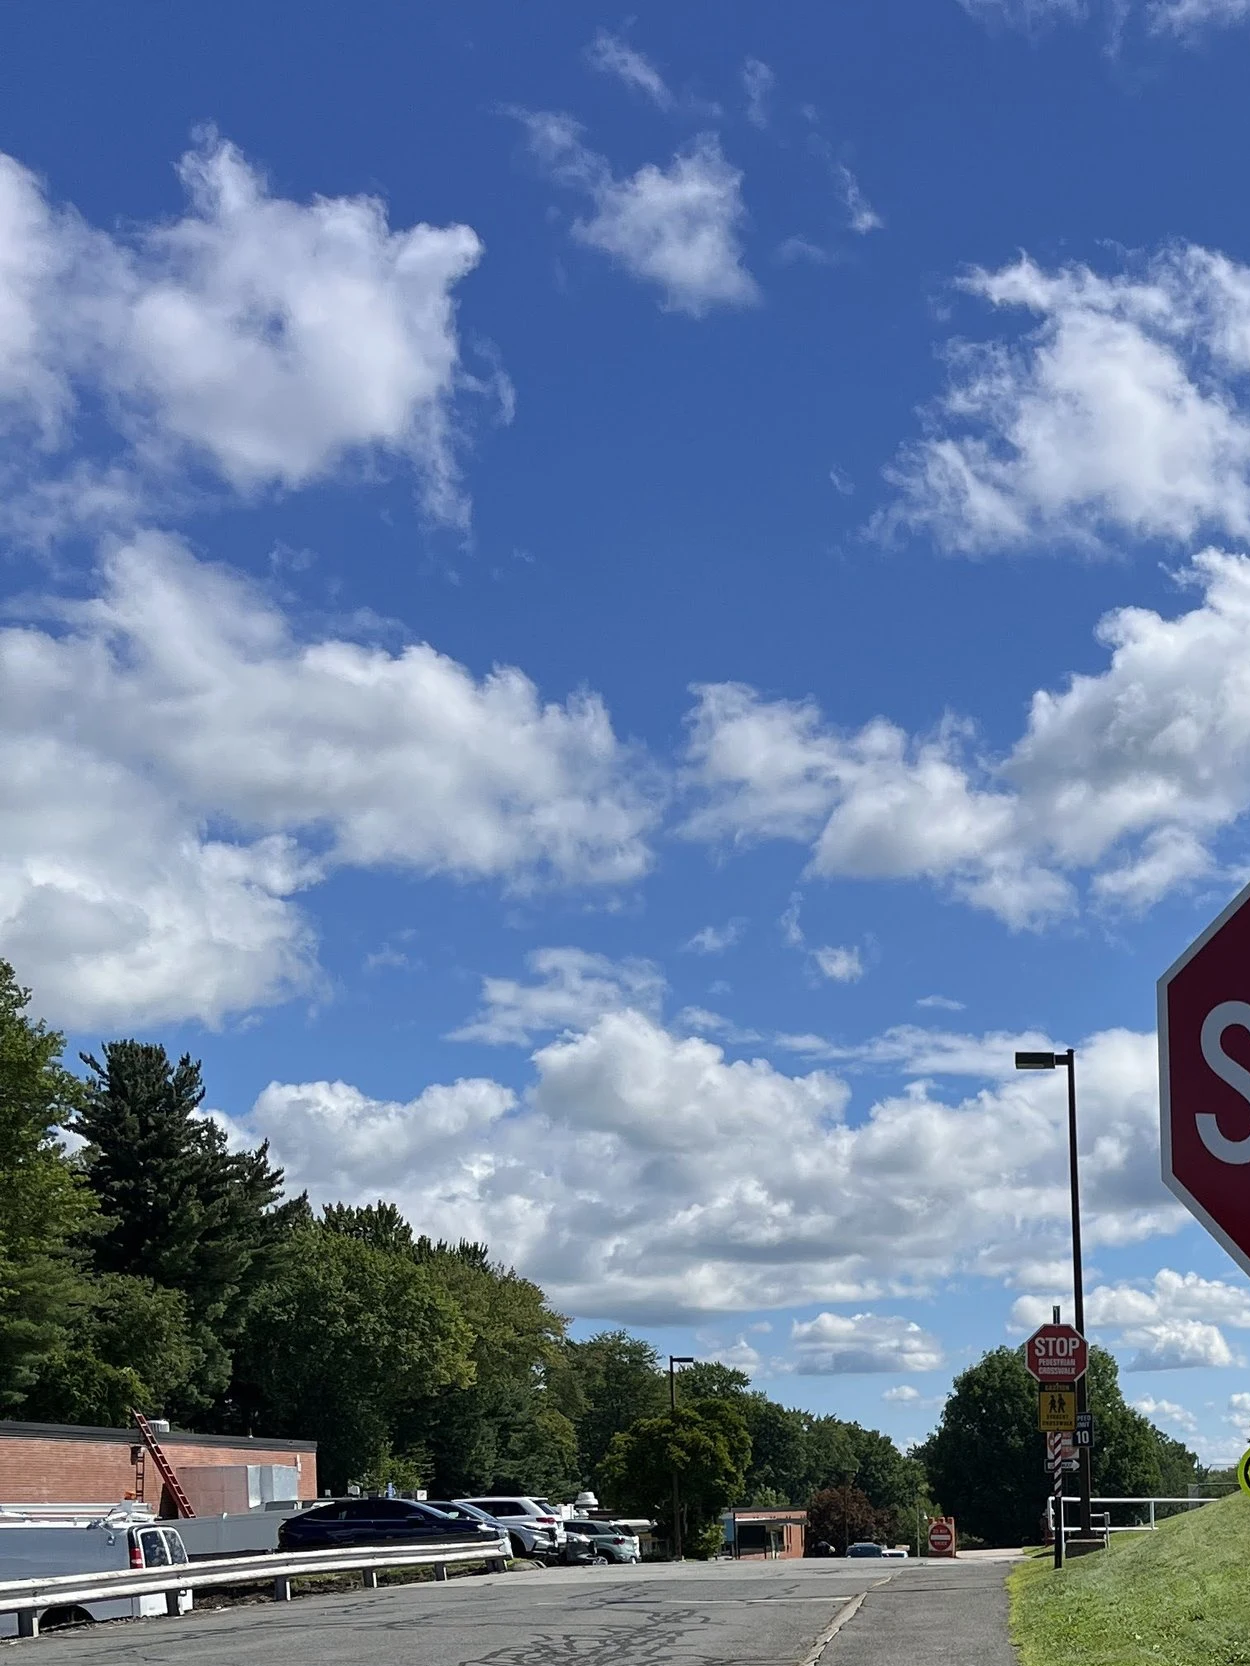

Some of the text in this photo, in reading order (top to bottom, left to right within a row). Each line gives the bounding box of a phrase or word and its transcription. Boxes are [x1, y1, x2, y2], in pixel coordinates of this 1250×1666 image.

[1034, 1337, 1080, 1357] STOP
[1038, 1358, 1076, 1366] PEDESTRIAN
[1038, 1367, 1076, 1375] CROSSWALK
[1076, 1430, 1090, 1444] 10
